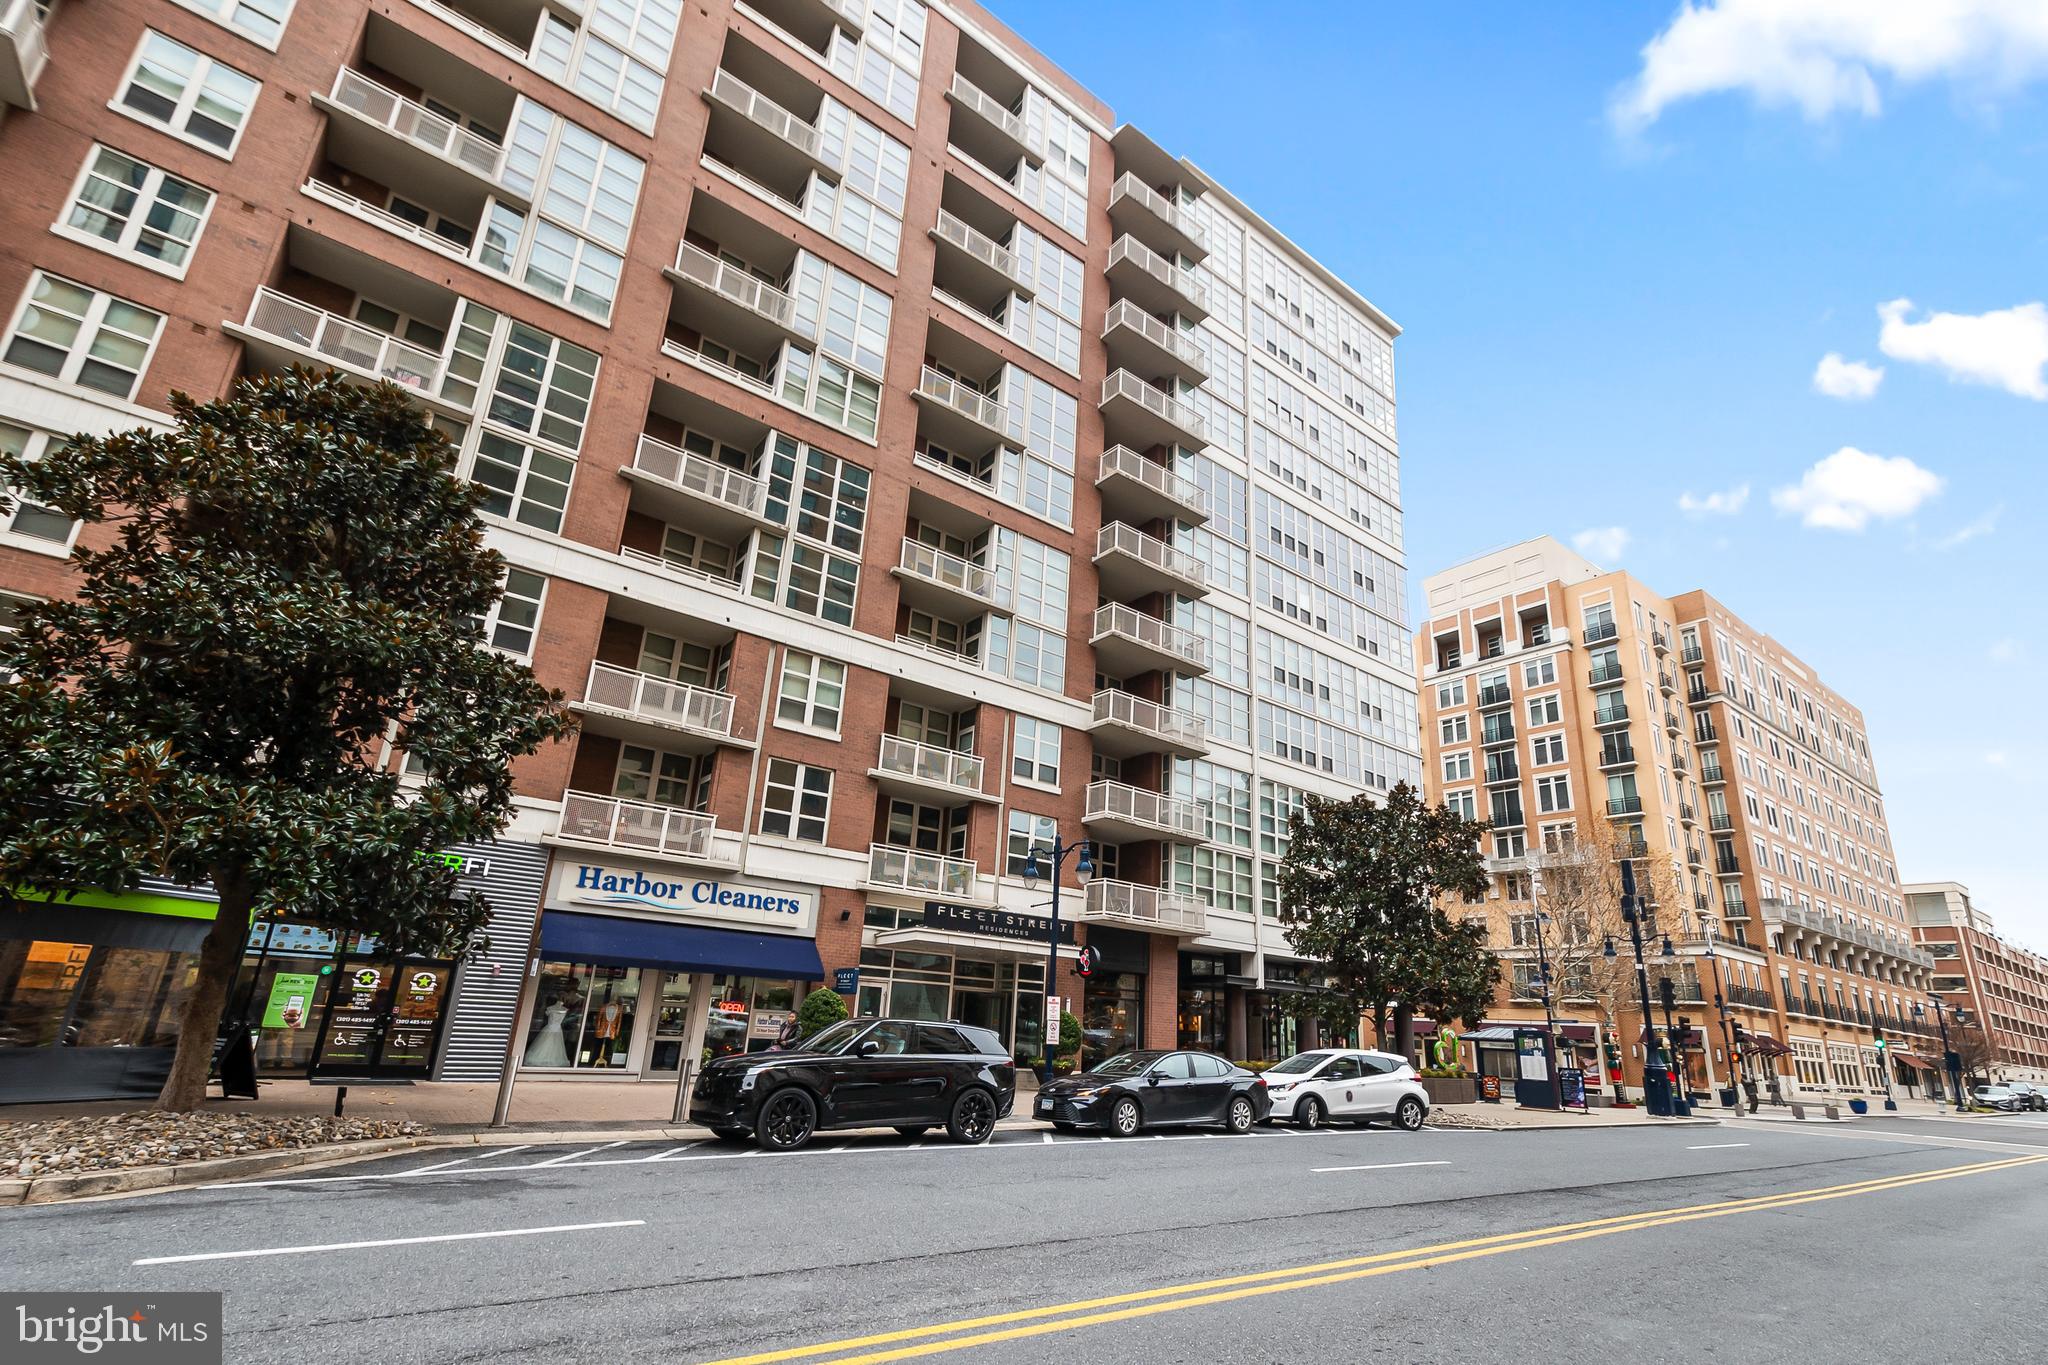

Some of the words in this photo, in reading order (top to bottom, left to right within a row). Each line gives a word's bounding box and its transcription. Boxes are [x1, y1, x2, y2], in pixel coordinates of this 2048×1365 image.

[575, 865, 683, 899] Harbor
[691, 881, 800, 914] Cleaners
[936, 905, 998, 923] FLEET
[979, 924, 1029, 937] RESIDENCES
[719, 1001, 745, 1013] OPEN
